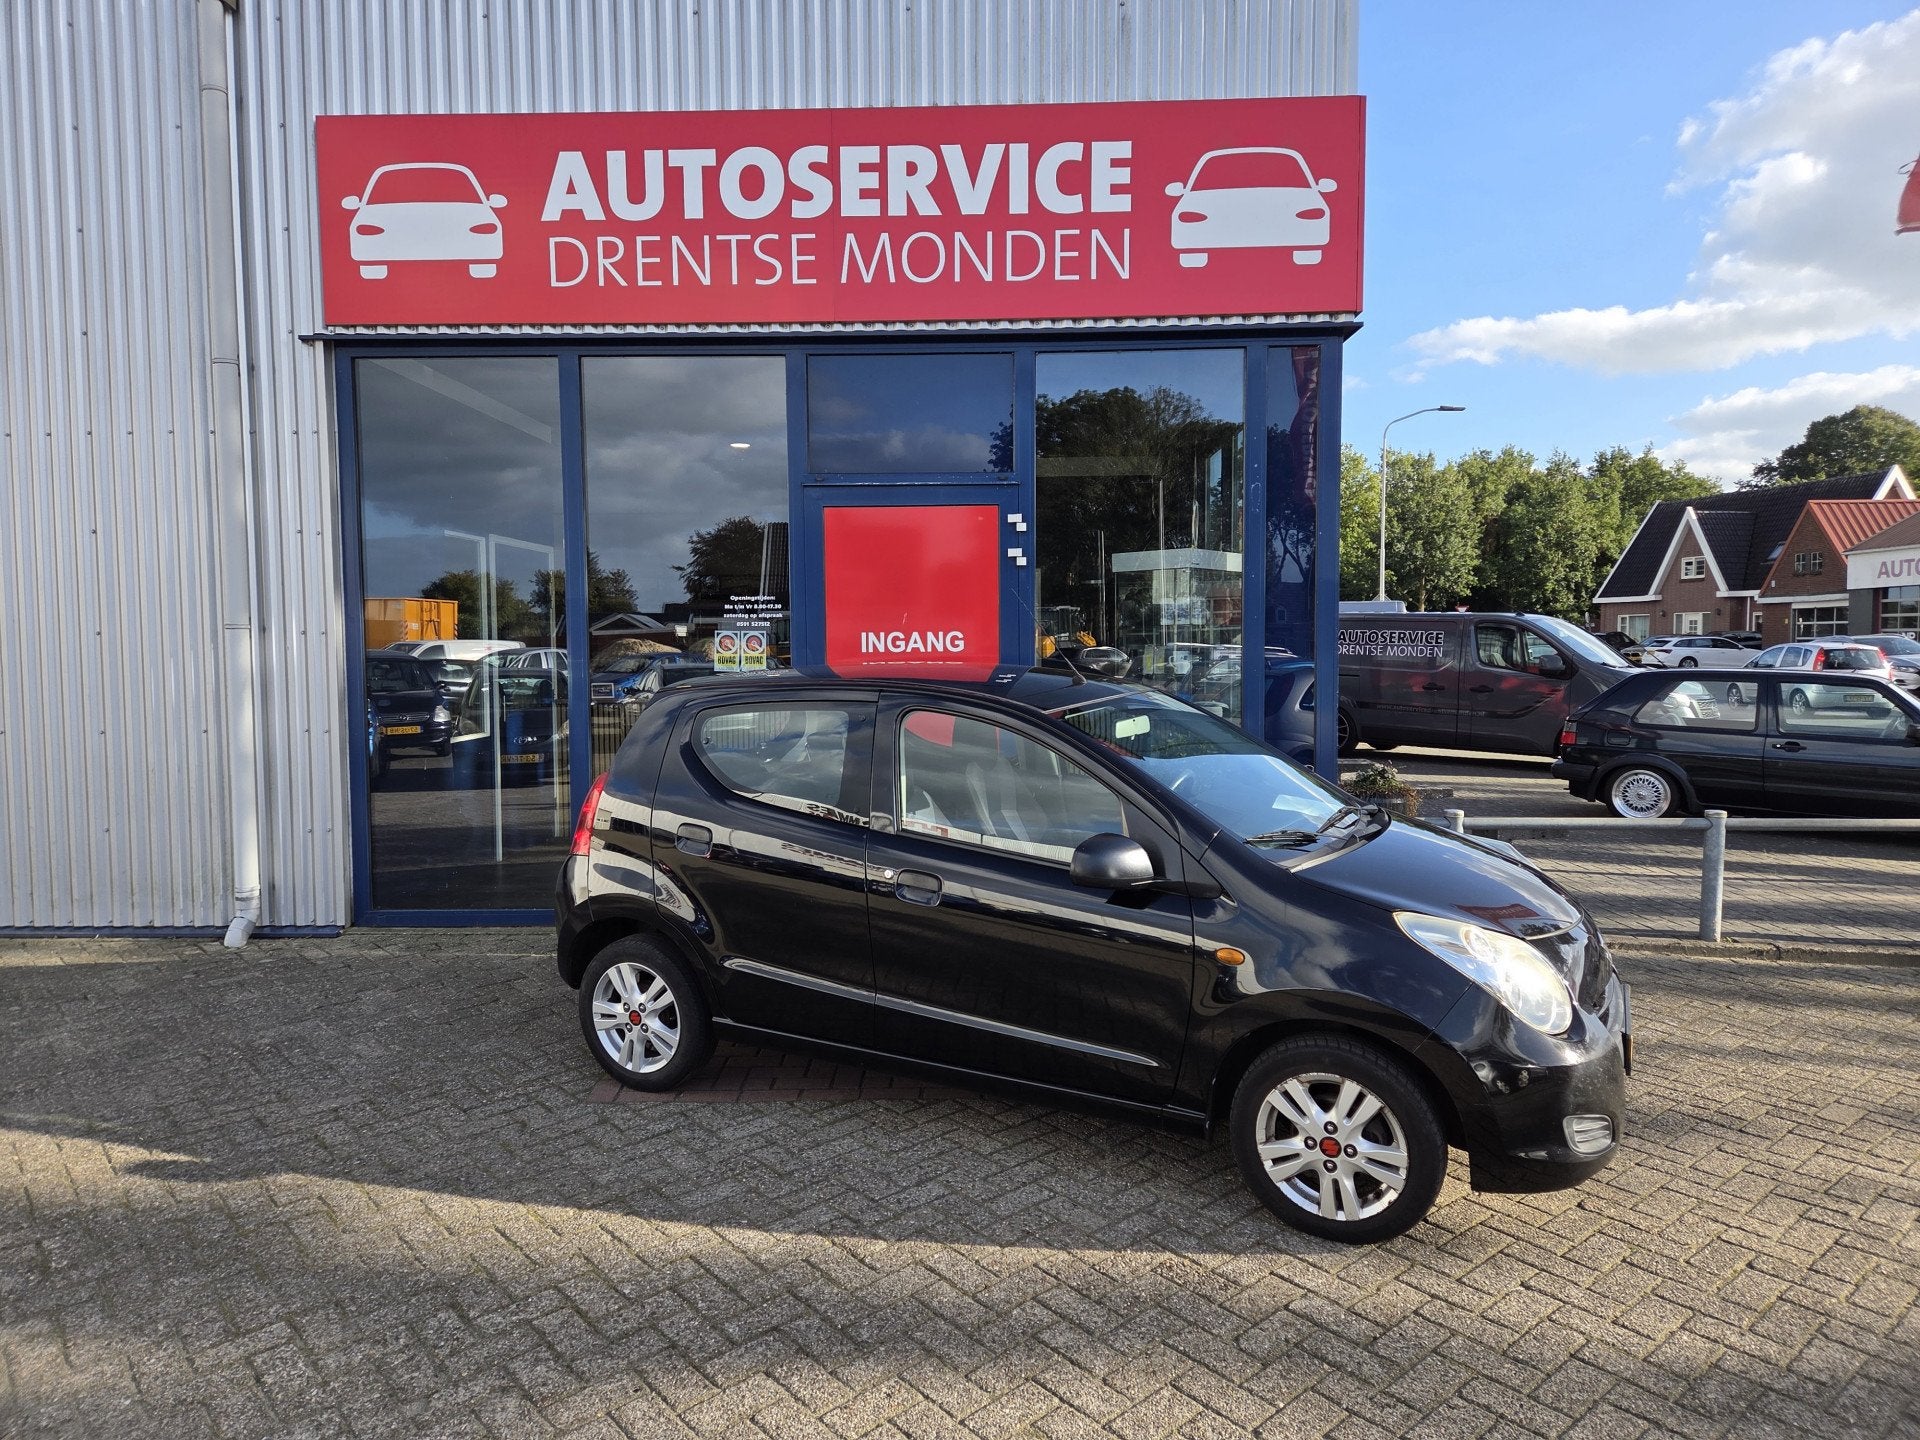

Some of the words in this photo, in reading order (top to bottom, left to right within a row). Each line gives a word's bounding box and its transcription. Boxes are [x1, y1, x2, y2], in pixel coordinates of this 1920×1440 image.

[541, 140, 1132, 221] AUTOSERVICE
[549, 233, 817, 287] DRENTSE
[840, 228, 1130, 283] MONDEN
[861, 631, 965, 653] INGANG
[1338, 629, 1444, 645] AUTOSERVICE
[1386, 645, 1443, 658] MONDEN
[717, 655, 737, 665] BOVAG
[745, 655, 764, 665] BOVAG
